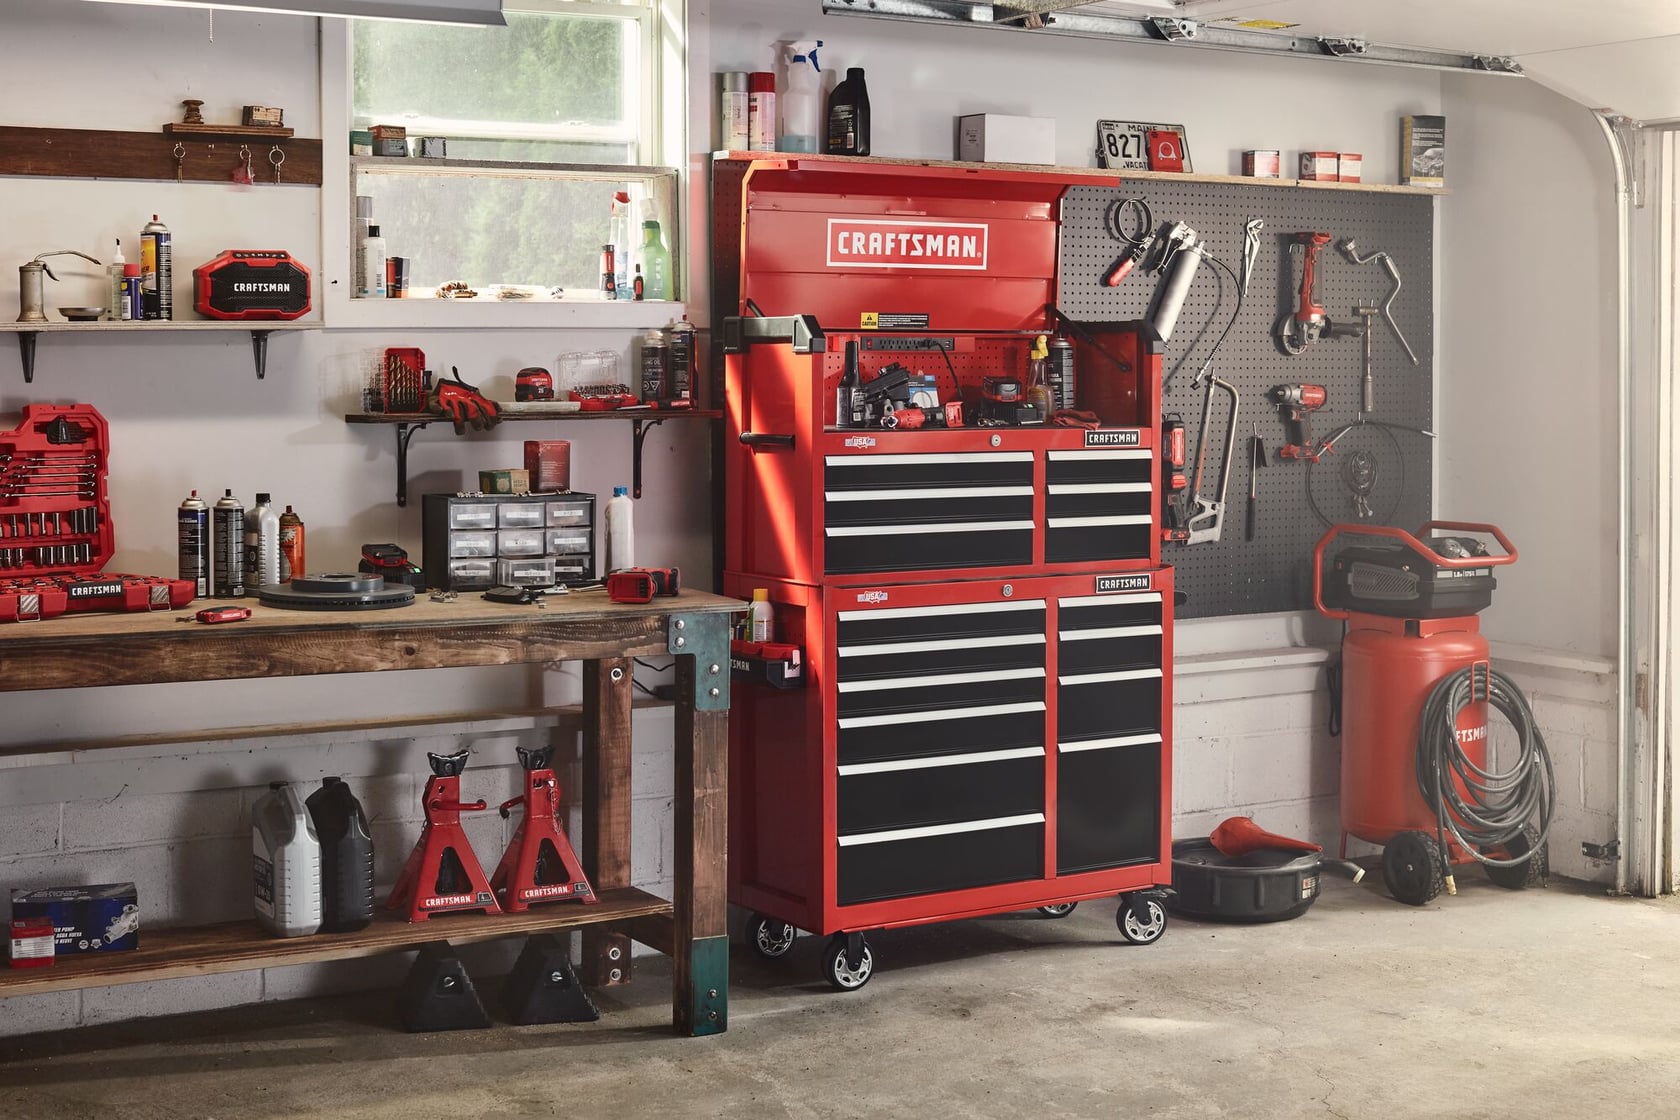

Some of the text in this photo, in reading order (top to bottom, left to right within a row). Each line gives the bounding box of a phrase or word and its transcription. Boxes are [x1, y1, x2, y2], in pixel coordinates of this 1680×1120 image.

[1127, 124, 1158, 132] MAINE
[1106, 133, 1147, 159] 827
[837, 231, 977, 258] CRAFTSMAN
[234, 283, 290, 292] CRAFTSMAN
[1088, 433, 1137, 443] CRAFTSMAN
[1100, 577, 1148, 589] CRAFTSMAN
[71, 584, 121, 596] CRAFTSMAN
[730, 659, 750, 672] TSMAN
[524, 886, 568, 898] CRAFTSMAN
[425, 895, 472, 907] CRAFTSMAN
